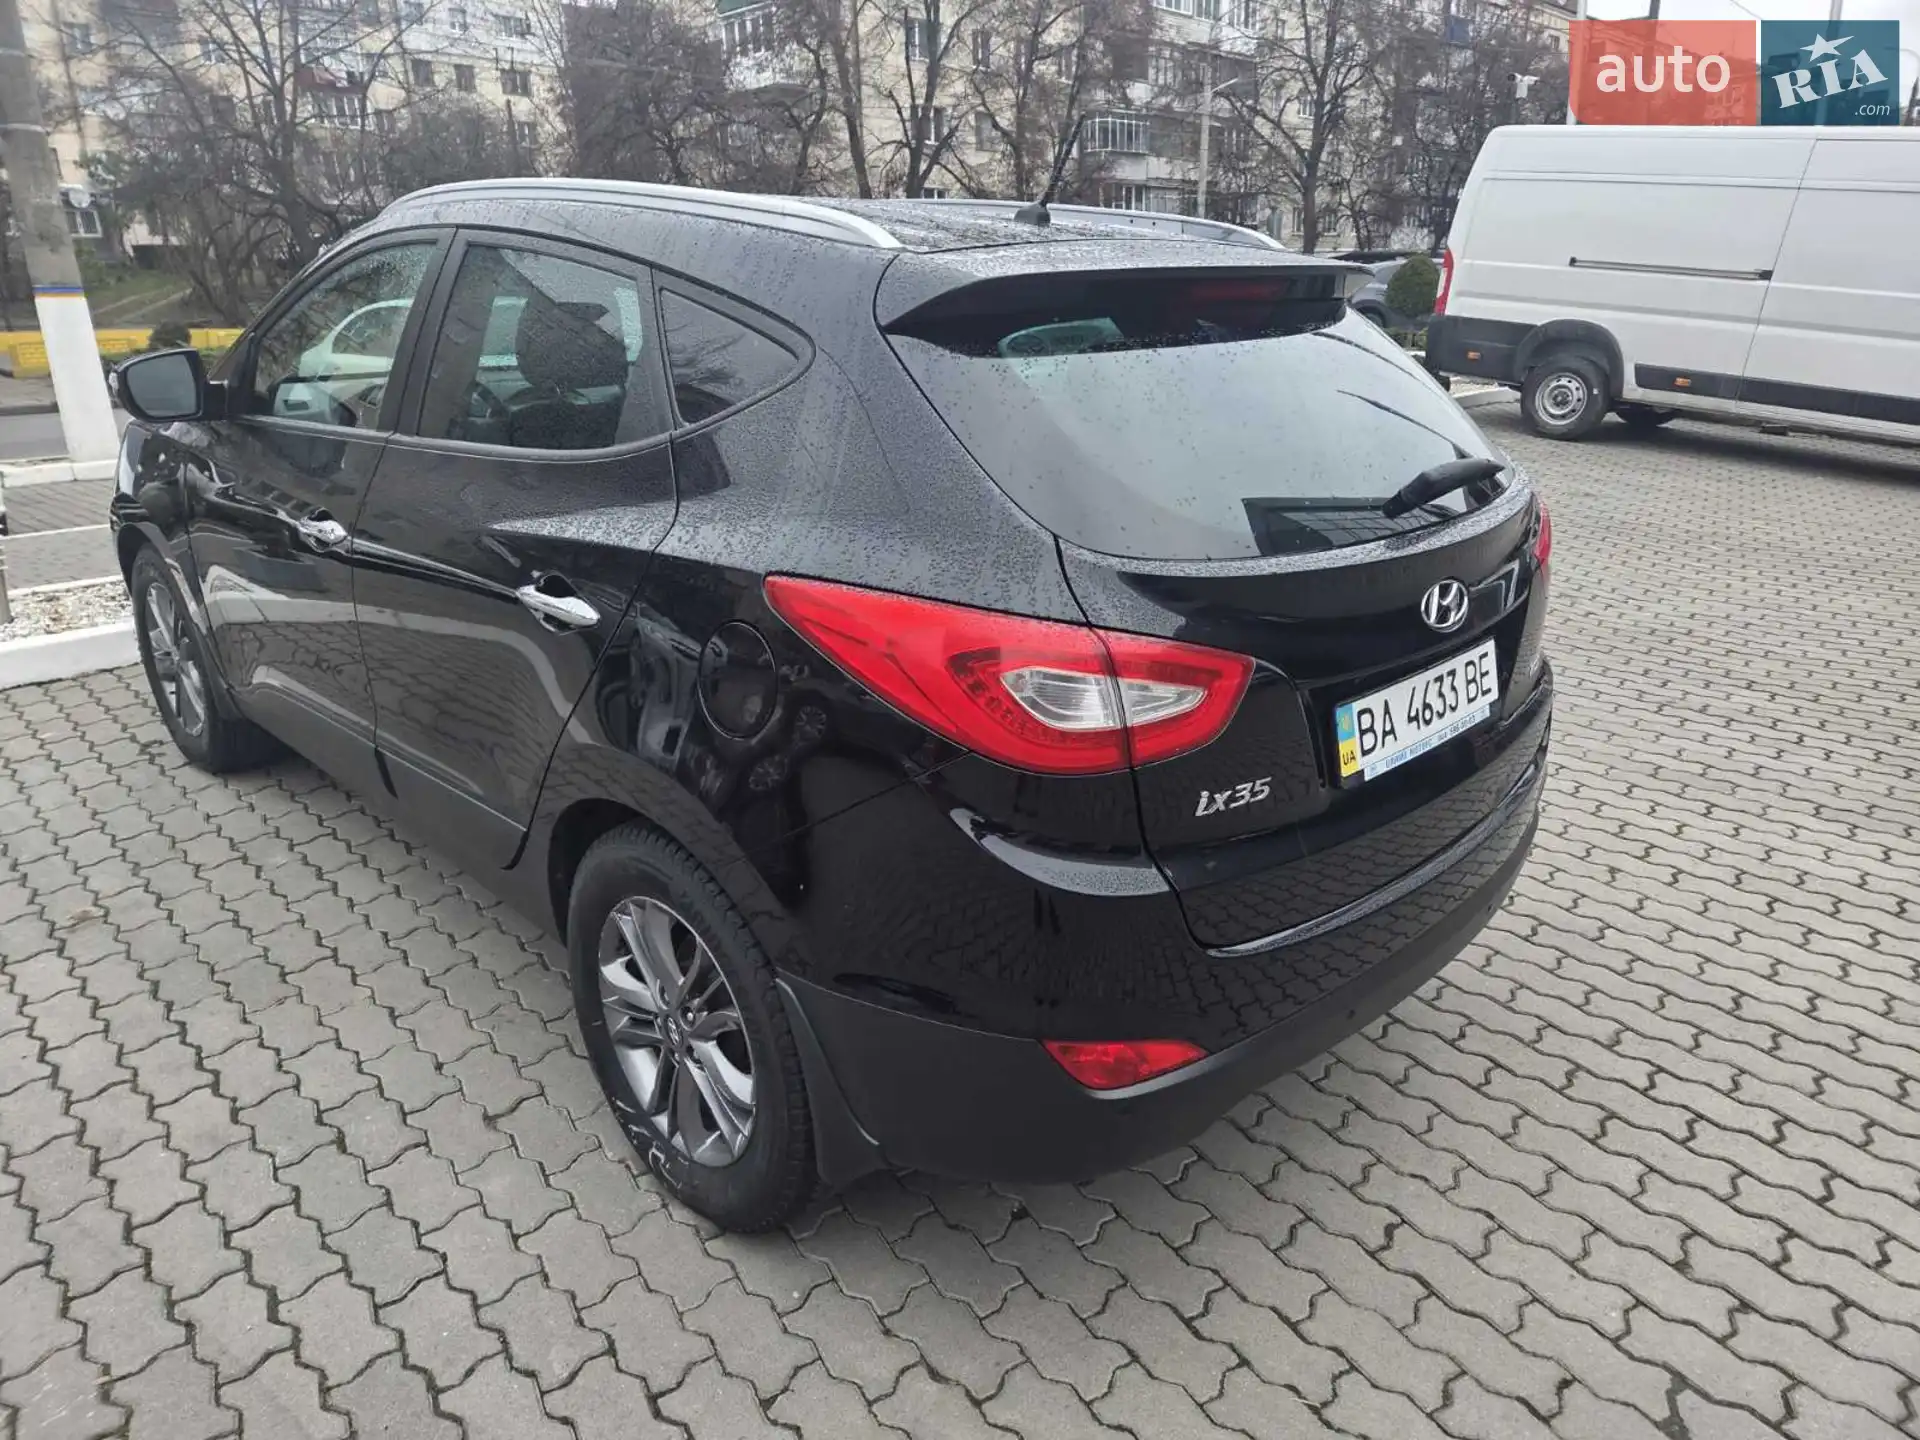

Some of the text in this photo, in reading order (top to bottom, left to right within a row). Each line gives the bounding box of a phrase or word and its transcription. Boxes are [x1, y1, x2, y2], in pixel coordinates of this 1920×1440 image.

[1357, 698, 1398, 757] BA
[1407, 668, 1459, 730] 4633
[1464, 651, 1492, 705] BE
[1342, 749, 1357, 766] UA
[1195, 777, 1272, 816] ix35
